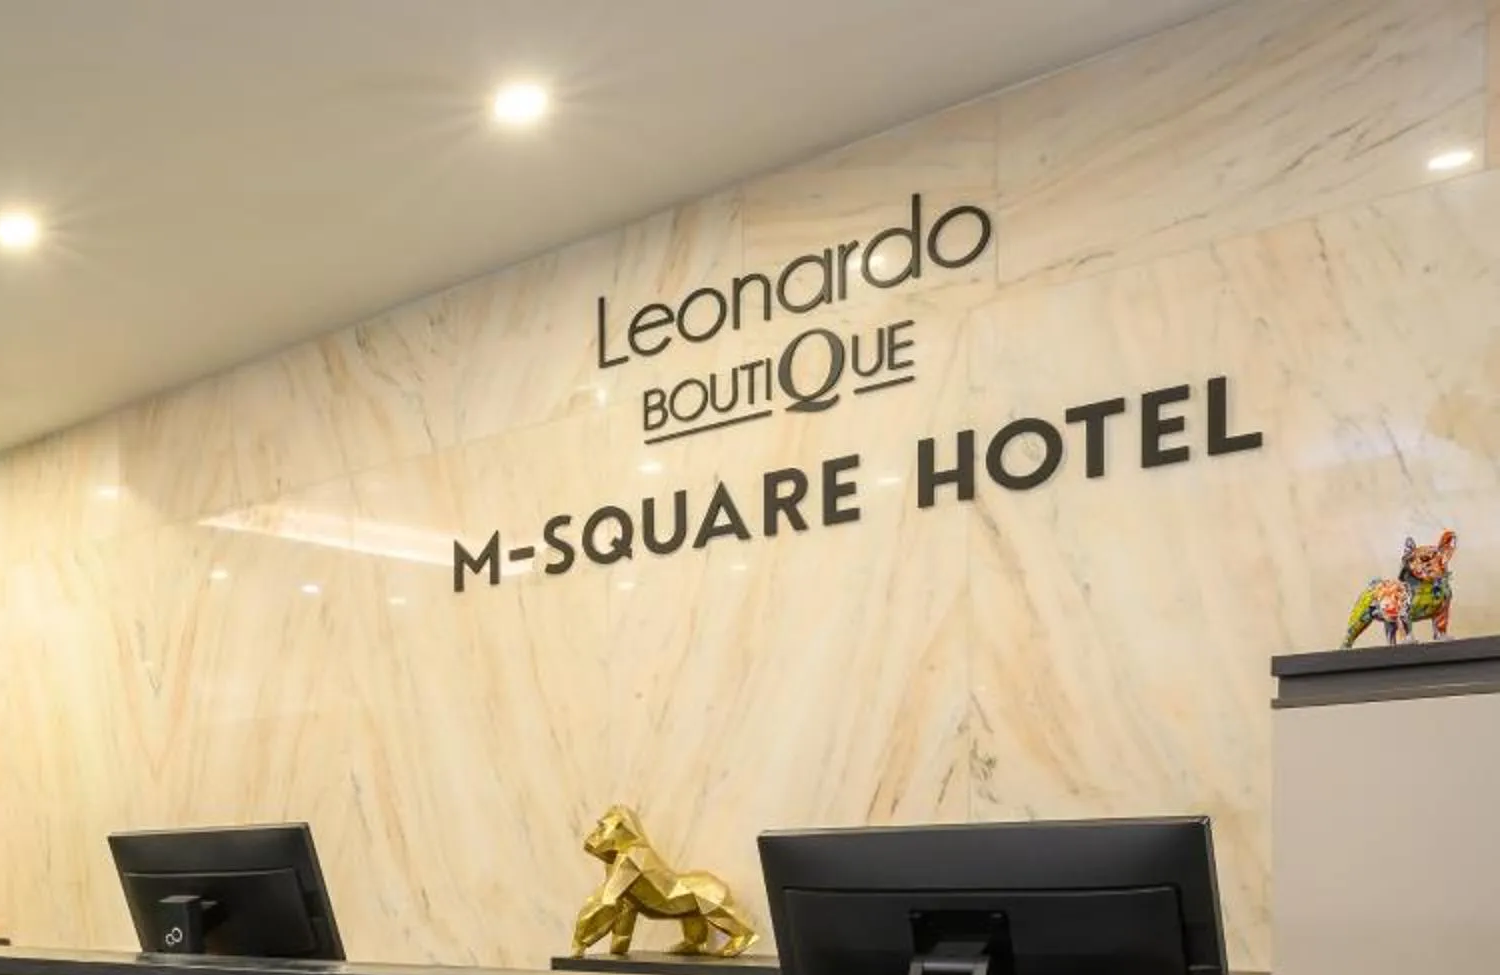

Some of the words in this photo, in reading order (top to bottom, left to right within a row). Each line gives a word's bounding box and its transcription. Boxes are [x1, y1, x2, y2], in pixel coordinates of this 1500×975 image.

[597, 191, 993, 370] Leonardo
[643, 319, 916, 432] BOUTIQUE
[453, 453, 861, 594] M-SQUARE
[916, 375, 1264, 510] HOTEL
